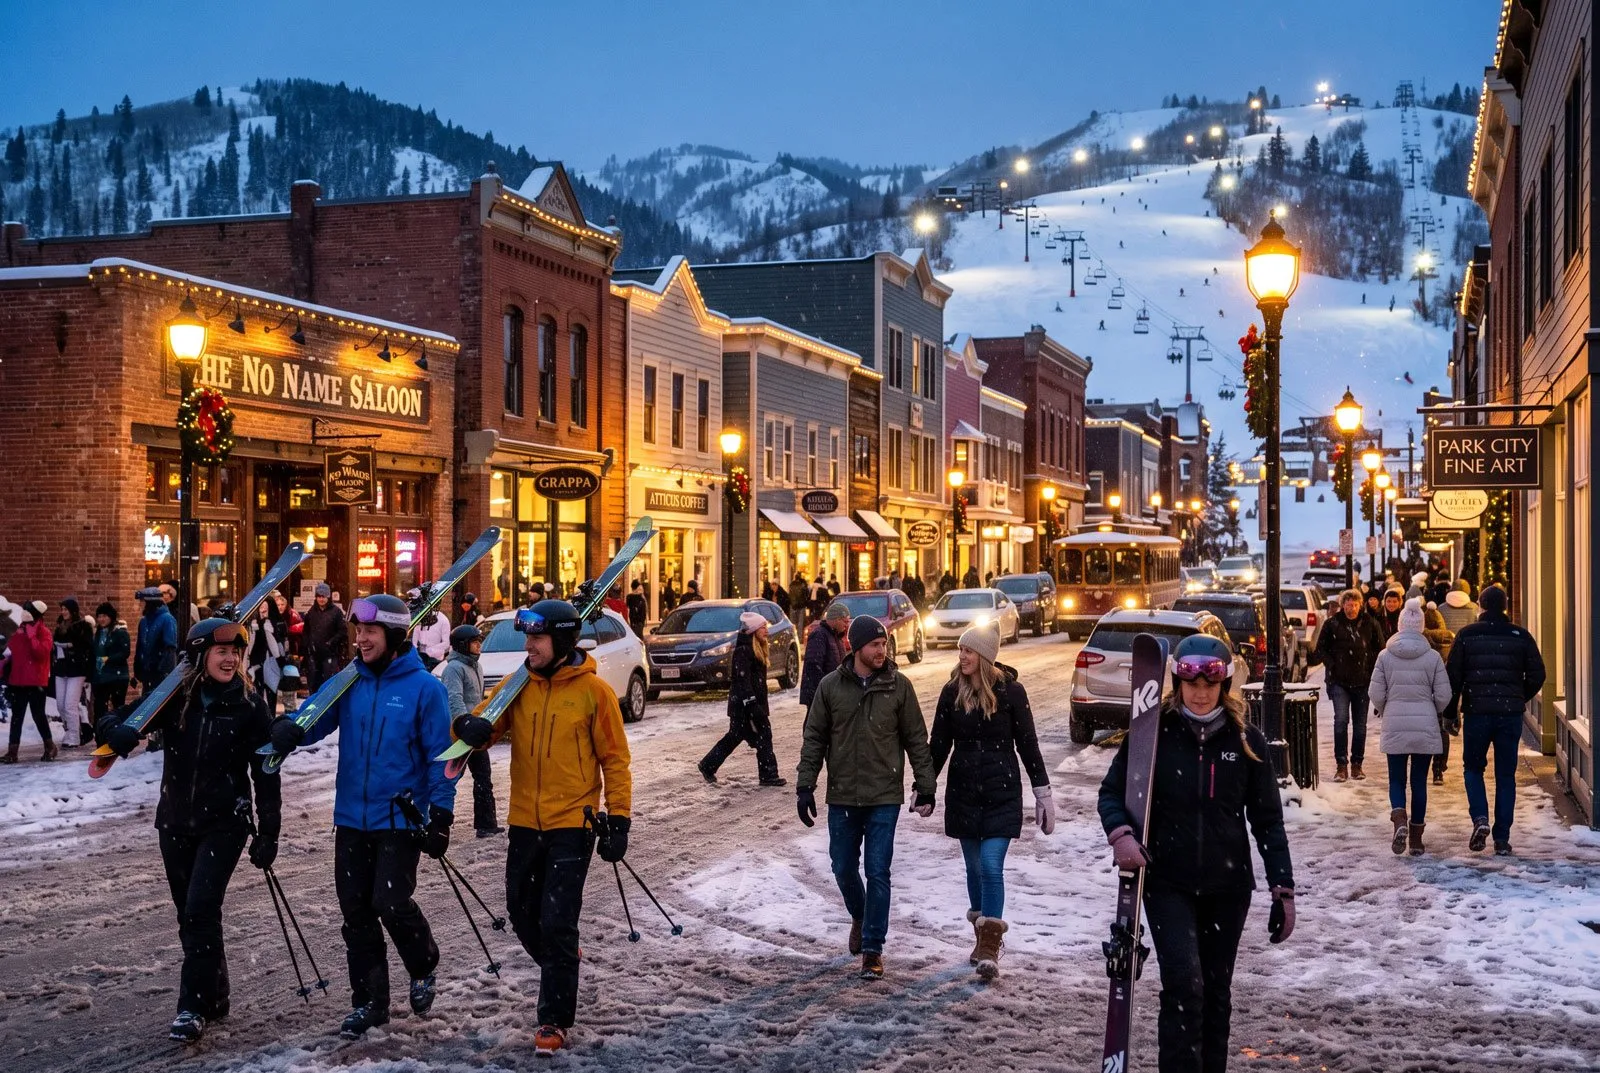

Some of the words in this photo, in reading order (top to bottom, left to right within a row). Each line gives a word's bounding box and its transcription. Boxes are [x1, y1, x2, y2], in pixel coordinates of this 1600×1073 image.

[193, 354, 232, 389] HE
[242, 354, 275, 396] NO
[282, 362, 343, 406] NAME
[350, 374, 422, 417] SALOON
[1438, 438, 1486, 454] PARK
[1490, 438, 1533, 454] CITY
[1444, 458, 1485, 474] FINE
[1490, 458, 1527, 473] ART
[539, 476, 591, 489] GRAPPA
[649, 492, 680, 507] ATTICUS
[680, 495, 706, 509] COFFEE
[1132, 679, 1159, 720] K2
[1221, 751, 1236, 761] K2
